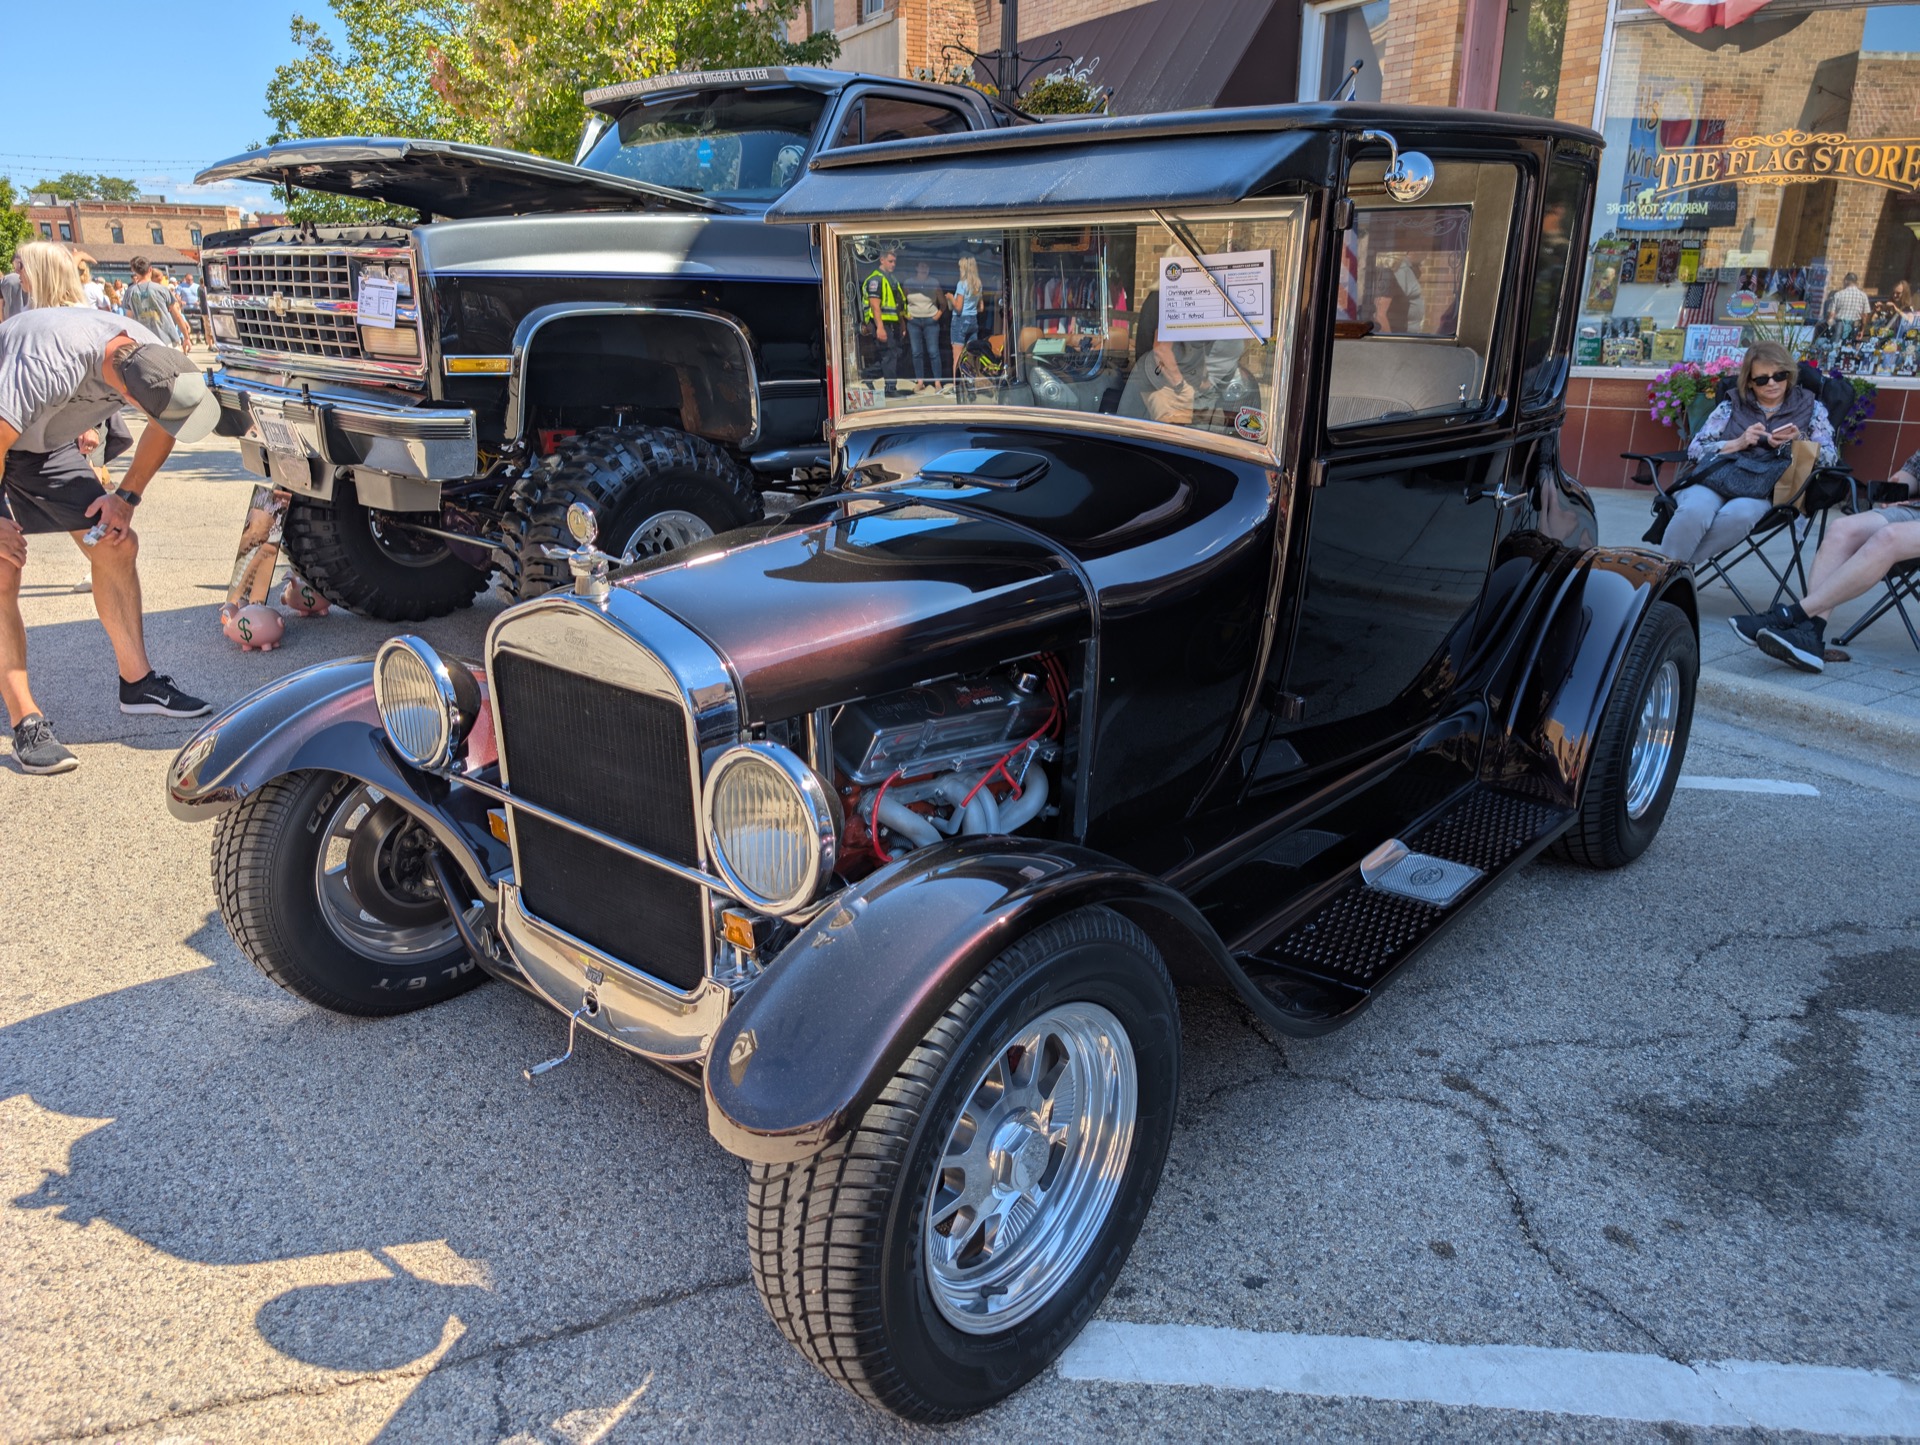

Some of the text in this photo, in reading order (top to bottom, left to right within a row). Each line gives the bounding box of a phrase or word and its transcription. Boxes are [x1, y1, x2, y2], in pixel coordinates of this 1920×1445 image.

[591, 89, 603, 101] OLD
[623, 82, 643, 94] NEVER
[655, 76, 672, 88] THEY
[673, 74, 689, 86] JUST
[690, 73, 703, 84] GET
[704, 71, 732, 83] BIGGER
[732, 70, 739, 81] &
[739, 68, 769, 80] BETTER
[1655, 144, 1920, 193] THE FLAG STORE
[1236, 288, 1257, 305] 53
[301, 585, 316, 609] $
[237, 616, 253, 643] $
